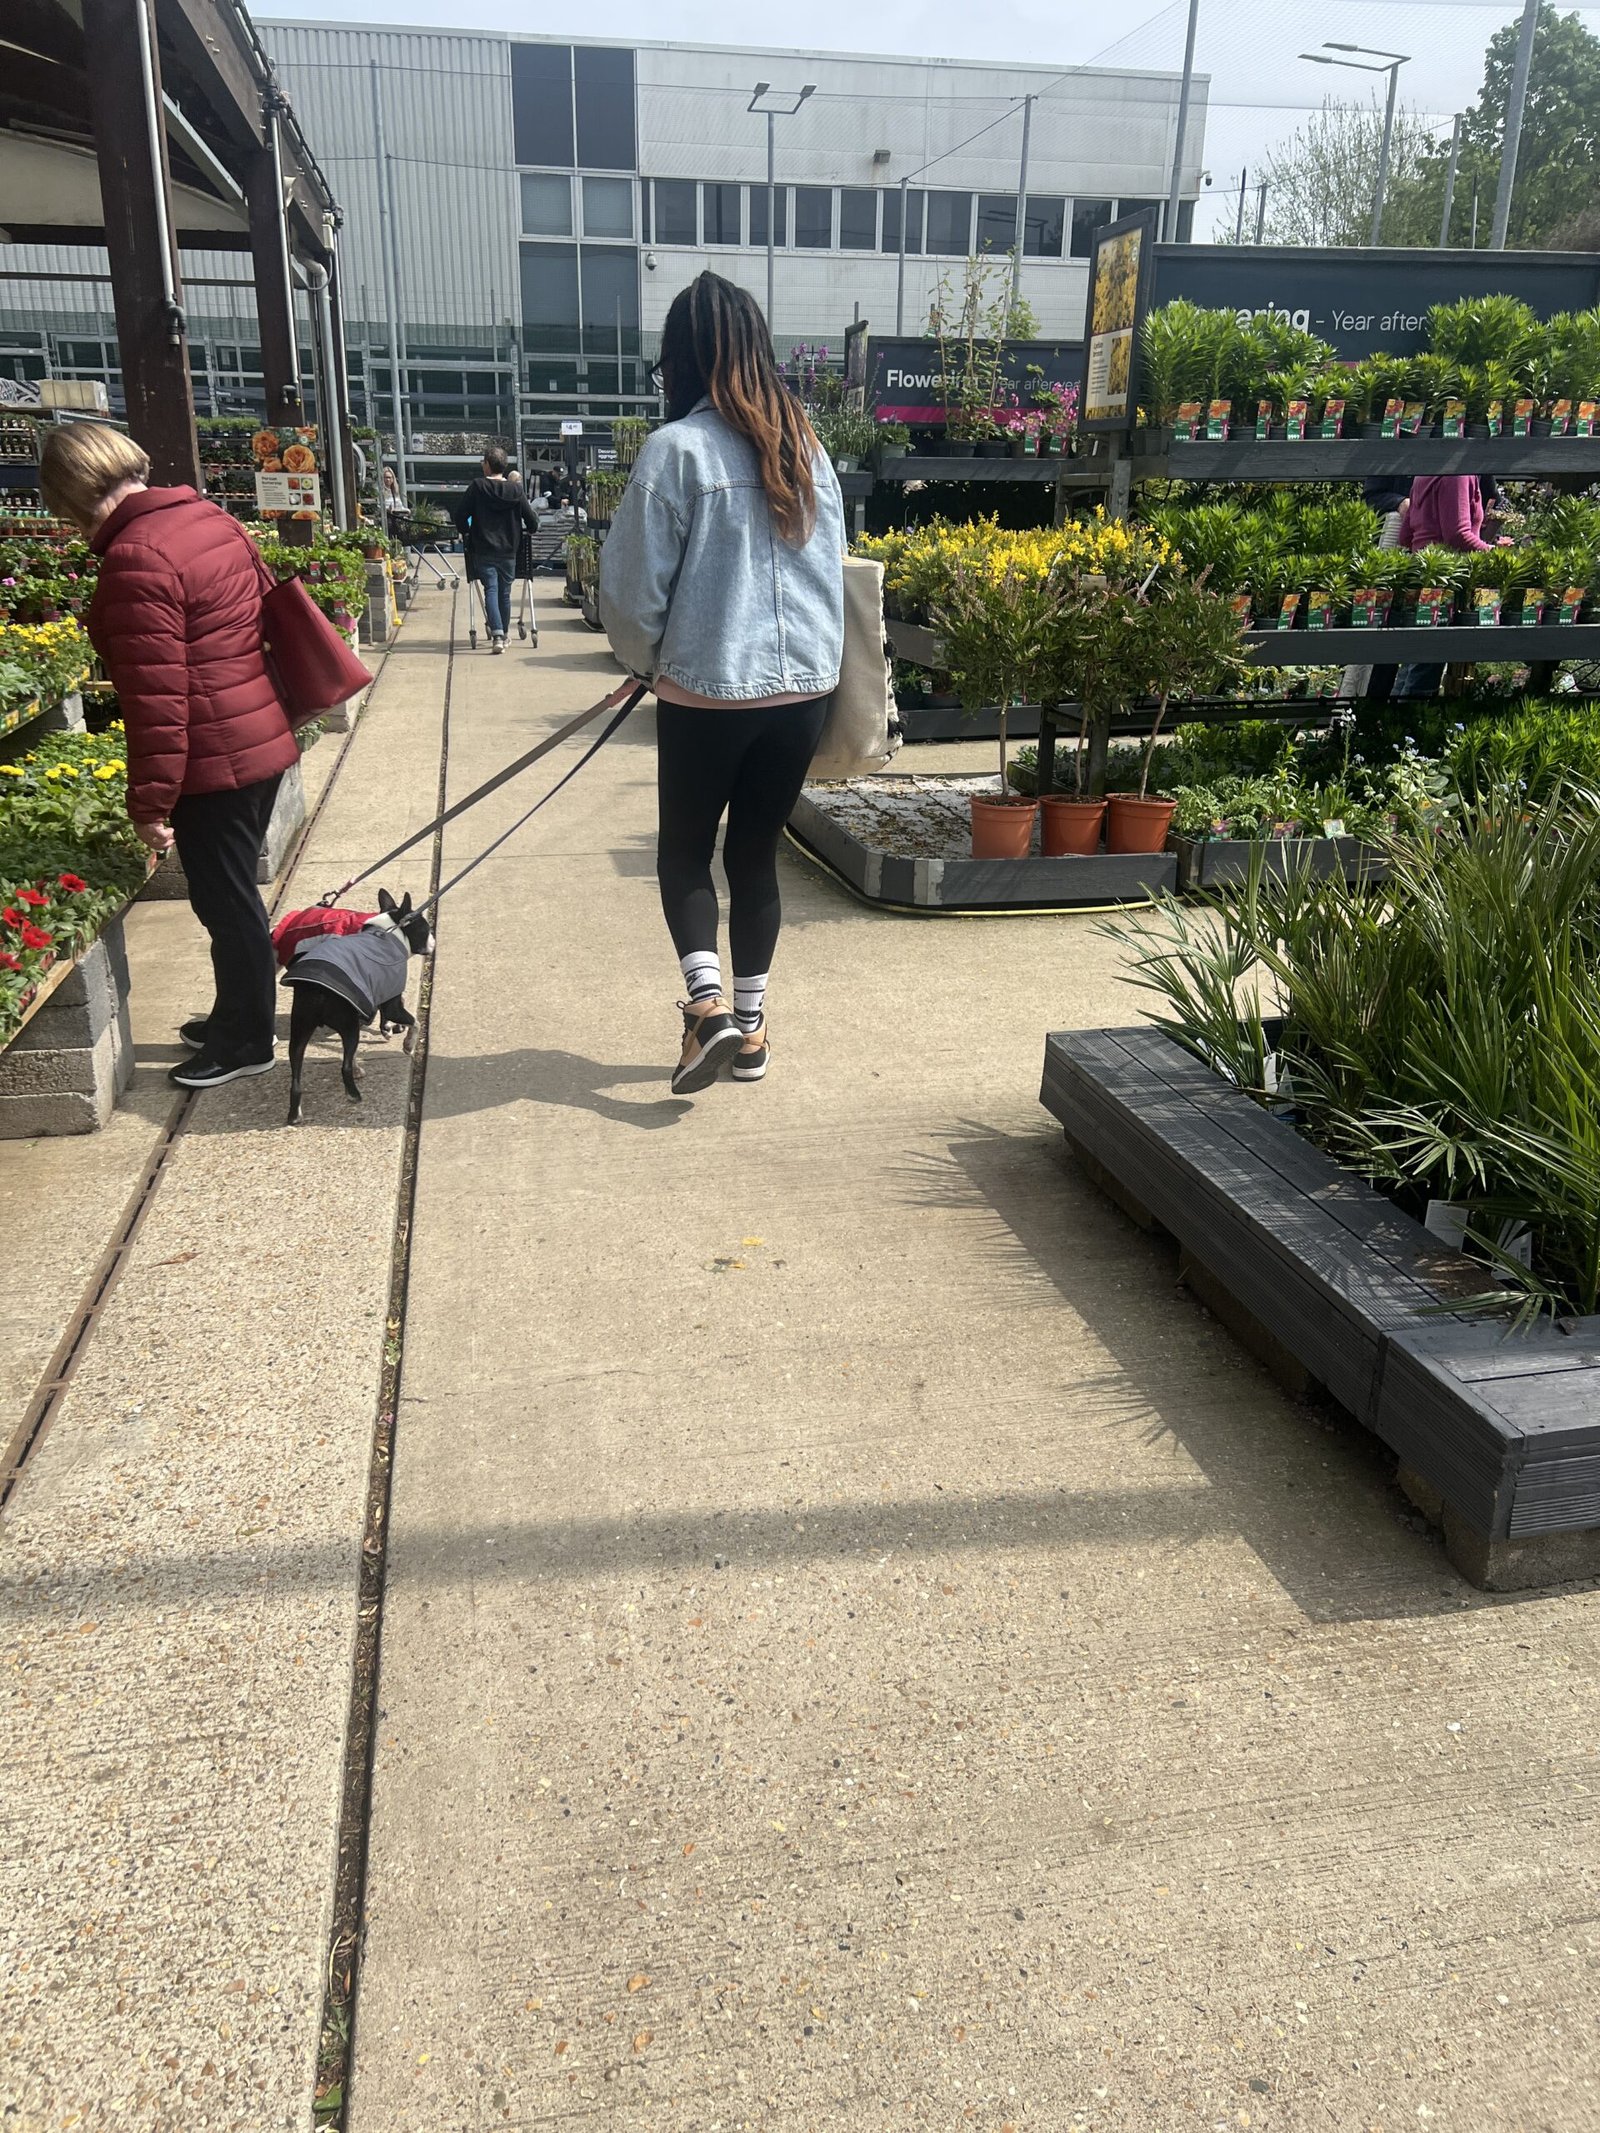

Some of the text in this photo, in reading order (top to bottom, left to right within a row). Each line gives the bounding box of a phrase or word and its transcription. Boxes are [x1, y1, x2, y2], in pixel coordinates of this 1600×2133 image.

[1332, 309, 1374, 331] Year
[1380, 310, 1428, 332] after
[886, 369, 980, 389] Flowein
